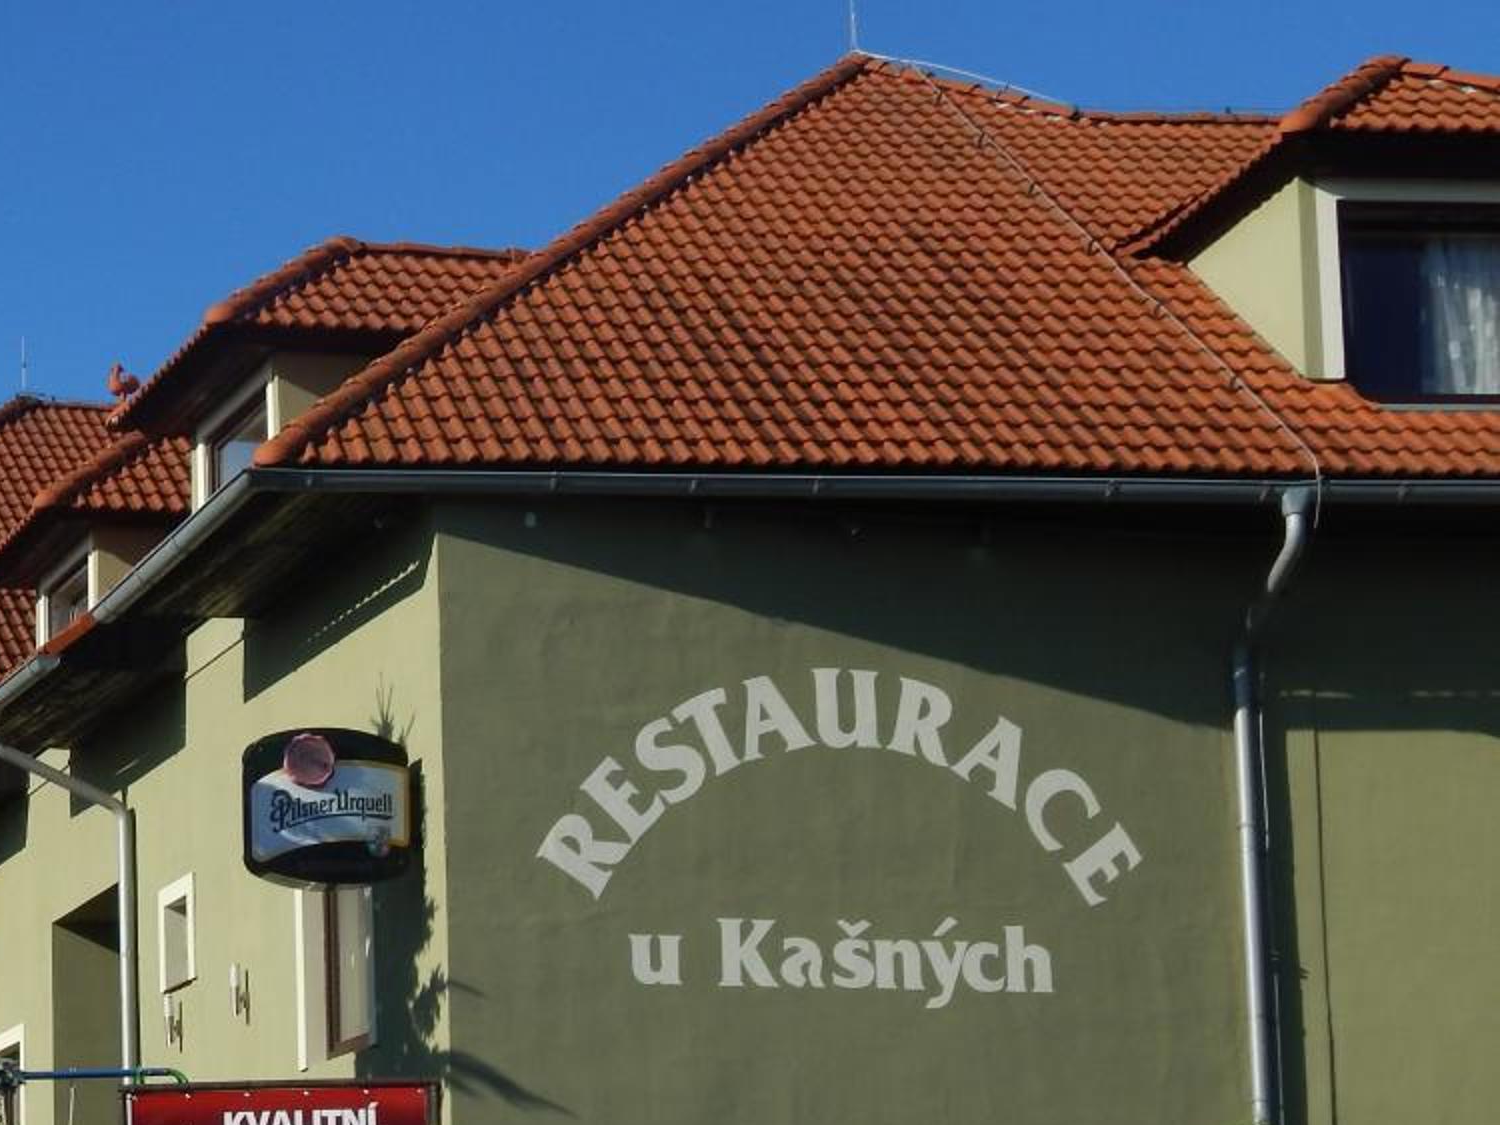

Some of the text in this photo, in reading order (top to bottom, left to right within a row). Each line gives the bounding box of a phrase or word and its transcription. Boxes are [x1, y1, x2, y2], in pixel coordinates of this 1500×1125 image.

[271, 789, 393, 832] Pilsner Urquell
[536, 668, 1142, 906] RESTAURACE
[628, 917, 1053, 1008] u Kašných
